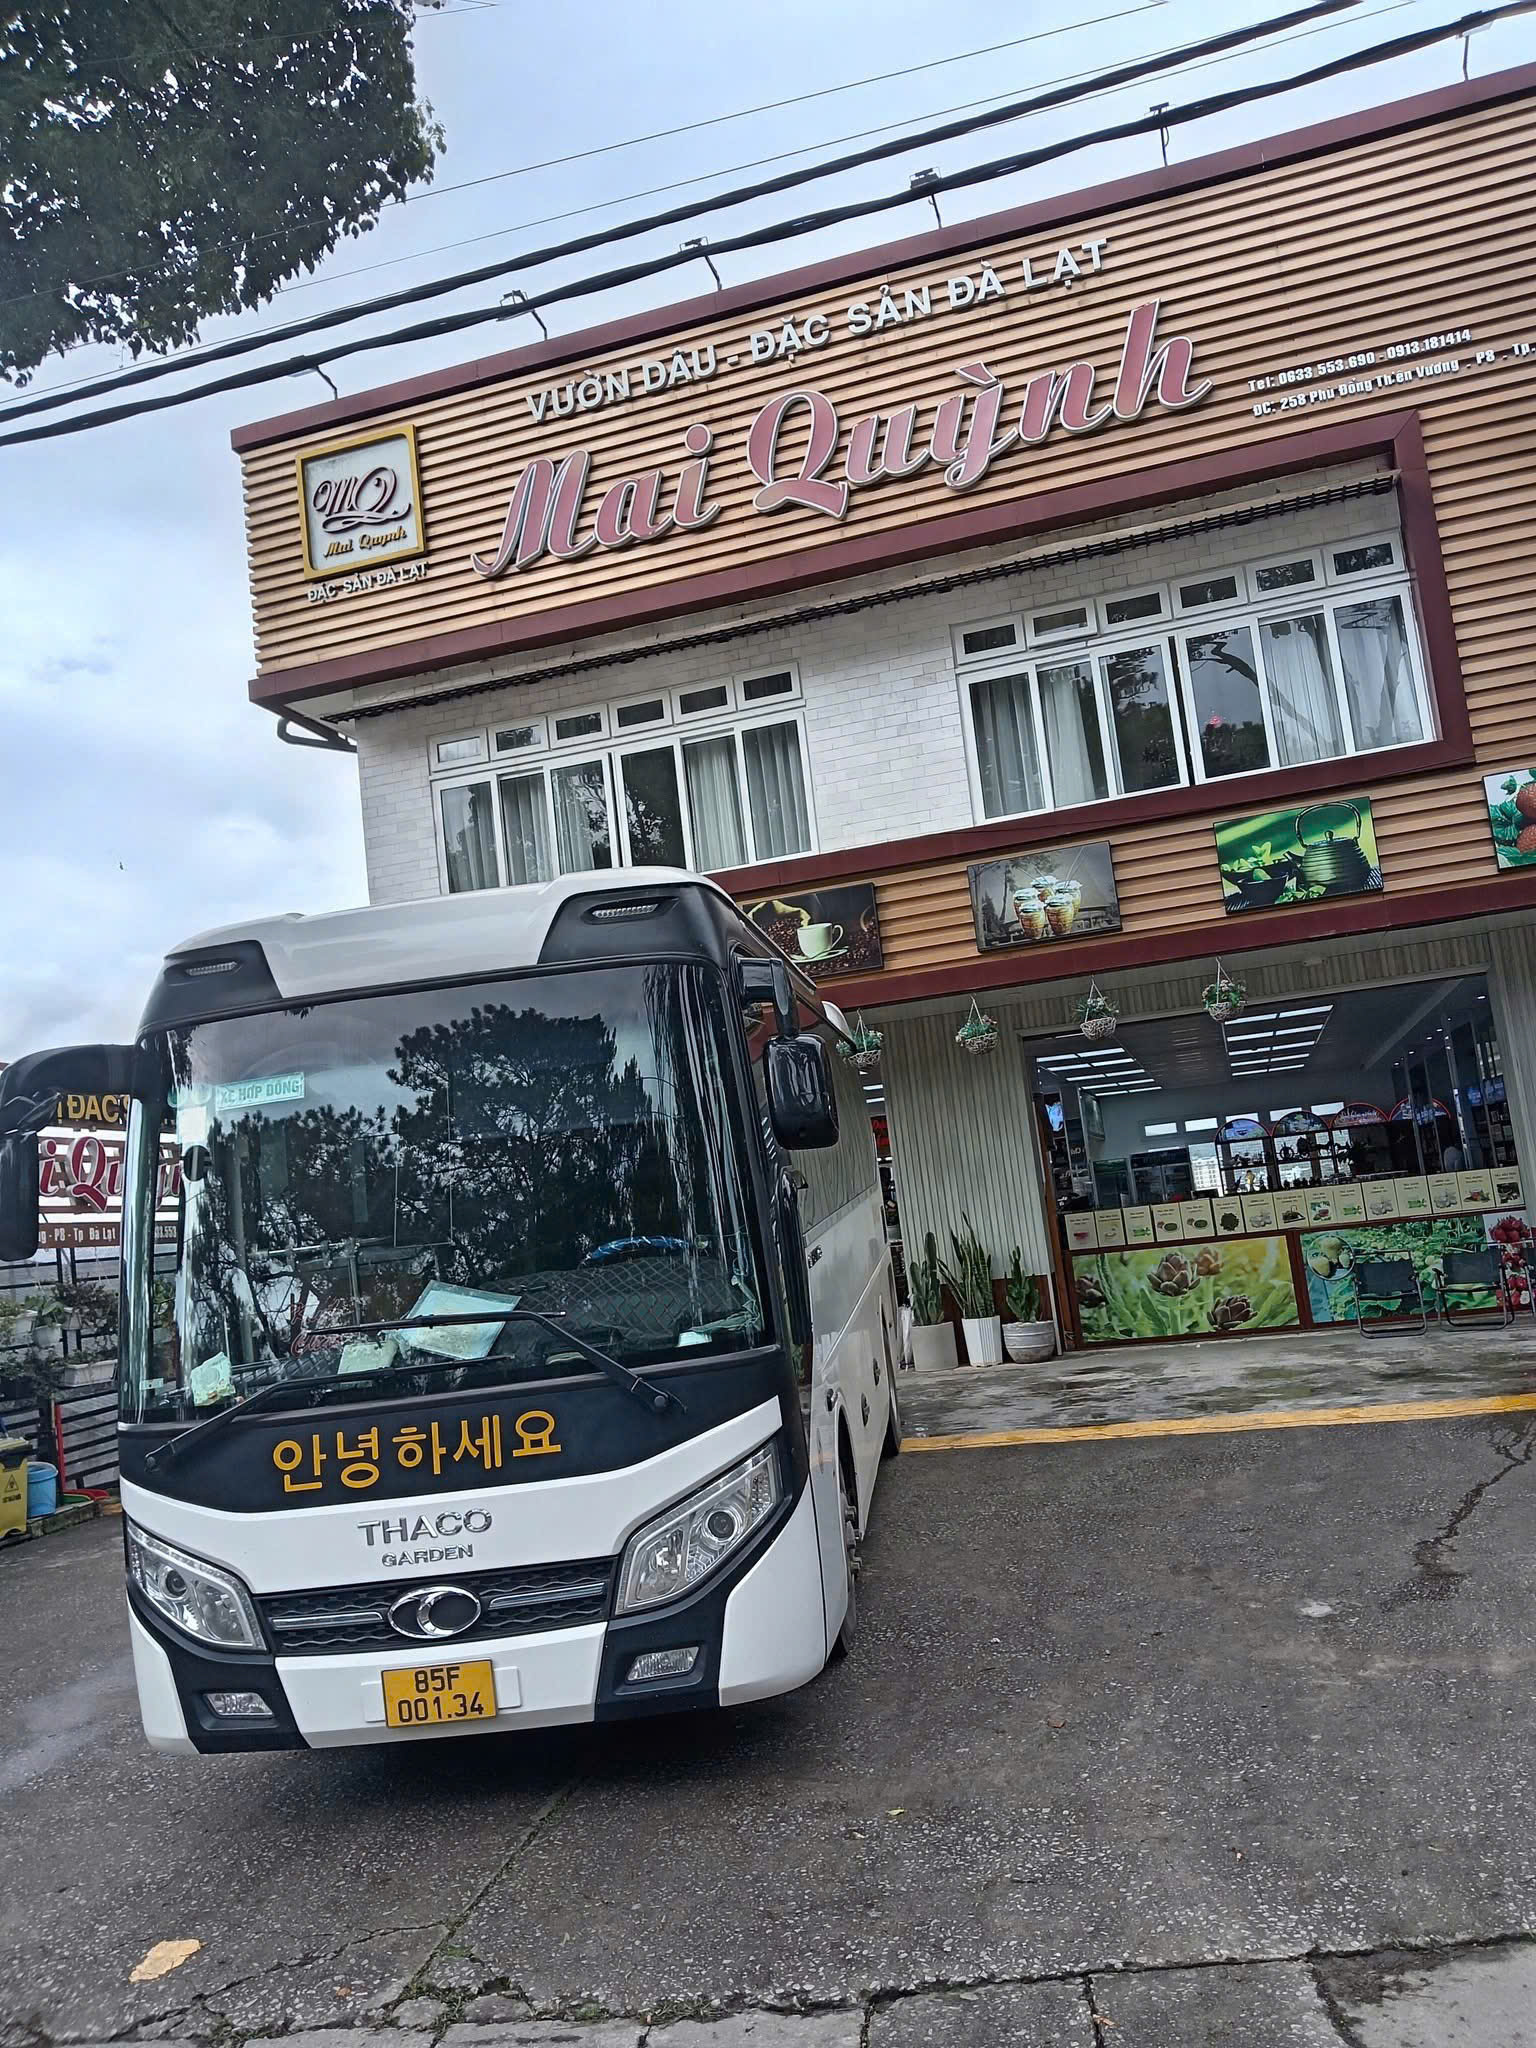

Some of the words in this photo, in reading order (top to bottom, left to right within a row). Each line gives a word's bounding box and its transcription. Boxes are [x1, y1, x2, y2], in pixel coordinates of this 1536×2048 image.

[526, 368, 632, 424] VƯỜN
[642, 344, 718, 393] DÂU
[727, 355, 741, 367] -
[750, 314, 831, 367] ĐẶC
[847, 283, 934, 336] SẢN
[947, 259, 1007, 310] ĐÀ
[1022, 238, 1108, 289] LẠT
[1248, 375, 1277, 393] Tel:
[1278, 366, 1314, 386] 0633
[1386, 328, 1472, 360] 0913.181414
[1280, 393, 1307, 410] 258
[1416, 359, 1460, 378] Vương
[1475, 349, 1496, 365] P8
[471, 423, 721, 578] Mai
[746, 297, 1215, 521] Quỳnh
[272, 1409, 562, 1493] 안녕하세요
[357, 1507, 493, 1546] THACO
[381, 1543, 474, 1568] GARDEN
[397, 1691, 485, 1723] 001.34
[414, 1666, 461, 1694] 85F
